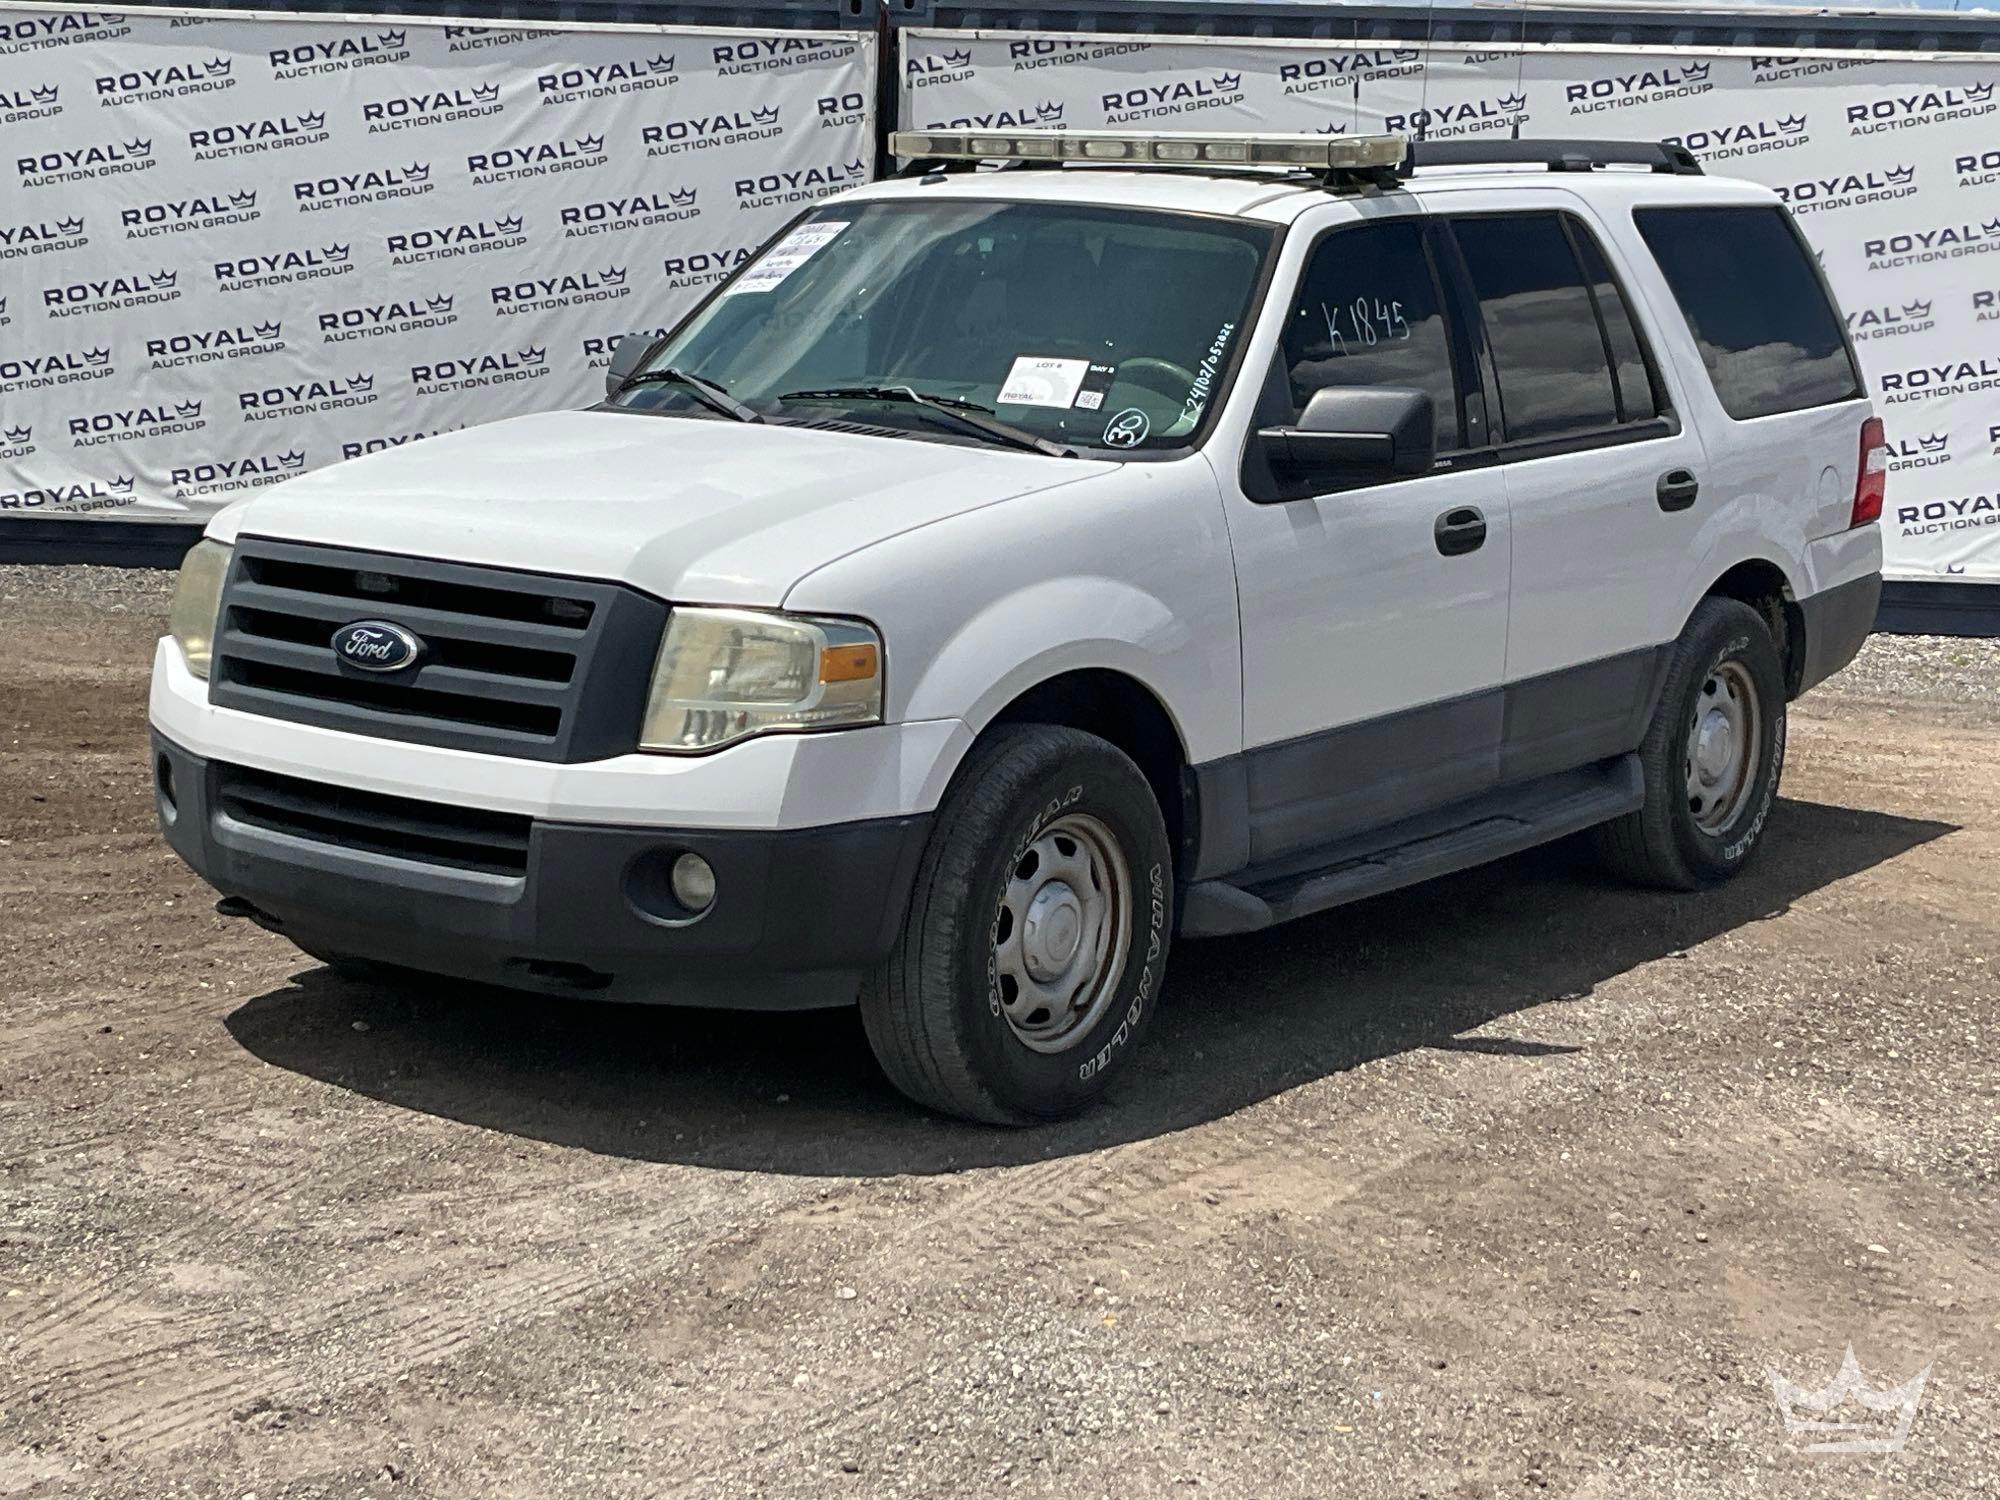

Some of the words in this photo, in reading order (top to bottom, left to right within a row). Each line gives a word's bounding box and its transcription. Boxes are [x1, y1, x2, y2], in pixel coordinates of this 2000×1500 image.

[0, 37, 69, 54] AUCTION
[73, 27, 131, 43] GROUP
[270, 36, 377, 67] ROYAL
[449, 32, 523, 52] AUCTION
[275, 61, 348, 80] AUCTION
[352, 51, 410, 68] GROUP
[718, 58, 792, 77] AUCTION
[796, 46, 855, 64] GROUP
[1014, 52, 1089, 72] AUCTION
[1280, 50, 1391, 82] ROYAL
[1754, 62, 1833, 83] AUCTION
[95, 64, 204, 95] ROYAL
[538, 62, 646, 93] ROYAL
[543, 86, 616, 106] AUCTION
[620, 77, 679, 92] GROUP
[917, 71, 975, 88] GROUP
[1284, 75, 1359, 95] AUCTION
[1363, 64, 1424, 82] GROUP
[1566, 69, 1680, 102] ROYAL
[101, 88, 174, 107] AUCTION
[178, 79, 236, 95] GROUP
[363, 90, 471, 121] ROYAL
[1102, 80, 1212, 111] ROYAL
[1570, 94, 1648, 115] AUCTION
[1652, 84, 1713, 101] GROUP
[1847, 90, 1962, 123] ROYAL
[5, 106, 63, 122] GROUP
[368, 114, 442, 134] AUCTION
[445, 105, 503, 121] GROUP
[822, 113, 866, 128] AUCT
[1106, 105, 1181, 124] AUCTION
[1185, 95, 1244, 112] GROUP
[1385, 101, 1497, 132] ROYAL
[1851, 115, 1930, 136] AUCTION
[1934, 104, 1996, 123] GROUP
[189, 118, 297, 148] ROYAL
[643, 112, 751, 145] ROYAL
[647, 138, 721, 157] AUCTION
[724, 129, 783, 144] GROUP
[195, 142, 268, 161] AUCTION
[271, 132, 329, 149] GROUP
[468, 141, 576, 172] ROYAL
[1747, 135, 1809, 154] GROUP
[17, 144, 126, 175] ROYAL
[23, 169, 95, 187] AUCTION
[99, 160, 156, 176] GROUP
[473, 166, 546, 185] AUCTION
[550, 157, 608, 173] GROUP
[294, 170, 403, 200] ROYAL
[735, 166, 843, 197] ROYAL
[1855, 186, 1917, 205] GROUP
[121, 197, 229, 226] ROYAL
[300, 193, 372, 212] AUCTION
[376, 184, 434, 200] GROUP
[561, 194, 669, 225] ROYAL
[739, 190, 813, 210] AUCTION
[0, 224, 57, 245] YAL
[126, 220, 199, 239] AUCTION
[203, 211, 260, 227] GROUP
[387, 221, 496, 253] ROYAL
[565, 218, 639, 238] AUCTION
[642, 210, 700, 225] GROUP
[31, 238, 88, 254] GROUP
[392, 246, 465, 266] AUCTION
[469, 237, 527, 253] GROUP
[1864, 225, 1981, 258] ROYAL
[1868, 250, 1948, 271] AUCTION
[1951, 241, 2000, 258] GROU
[214, 250, 323, 280] ROYAL
[664, 246, 760, 276] ROYA
[43, 276, 152, 306] ROYAL
[220, 274, 292, 292] AUCTION
[296, 264, 354, 281] GROUP
[491, 273, 600, 304] ROYAL
[669, 271, 731, 289] AUCTIO
[49, 300, 121, 318] AUCTION
[124, 291, 181, 307] GROUP
[319, 301, 427, 331] ROYAL
[496, 297, 569, 316] AUCTION
[572, 288, 630, 304] GROUP
[146, 328, 255, 357] ROYAL
[324, 324, 396, 343] AUCTION
[400, 315, 457, 331] GROUP
[1872, 321, 1935, 339] GROUP
[0, 354, 83, 379] OYAL
[152, 351, 224, 369] AUCTION
[228, 342, 286, 358] GROUP
[411, 353, 520, 384] ROYAL
[0, 377, 54, 393] CTION
[57, 368, 114, 384] GROUP
[416, 377, 489, 396] AUCTION
[492, 368, 550, 384] GROUP
[1881, 360, 1998, 392] ROYAL
[239, 380, 348, 410] ROYAL
[1885, 384, 1963, 405] AUCTION
[1968, 378, 2000, 391] GRO
[69, 407, 176, 436] ROYAL
[244, 403, 317, 422] AUCTION
[320, 394, 378, 410] GROUP
[74, 430, 145, 447] AUCTION
[149, 421, 206, 436] GROUP
[0, 446, 36, 459] OUP
[1889, 454, 1951, 471] GROUP
[171, 457, 278, 485] ROYAL
[0, 482, 106, 509] ROYAL
[80, 496, 137, 511] GROUP
[175, 480, 248, 498] AUCTION
[1898, 493, 2000, 524] ROYA
[1902, 517, 1981, 537] AUCTION
[345, 629, 394, 660] Ford
[1079, 863, 1165, 1080] WRANGLER
